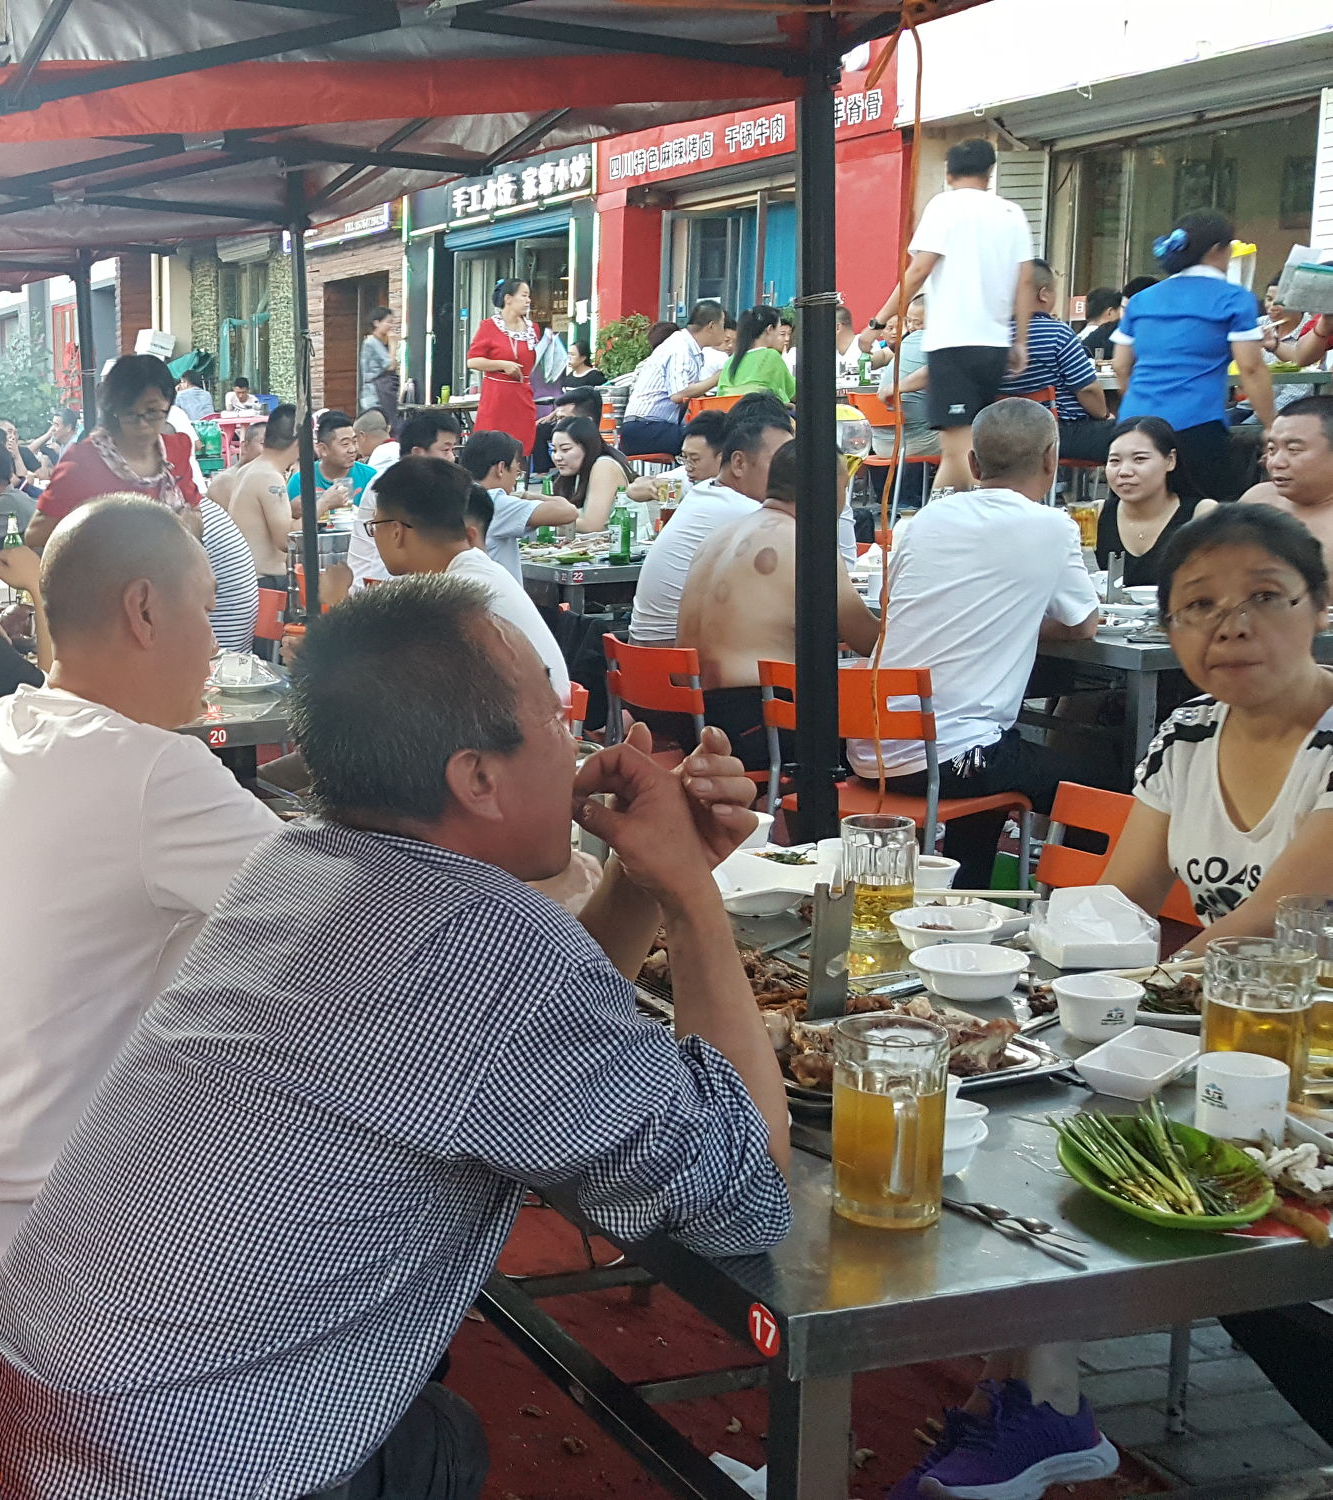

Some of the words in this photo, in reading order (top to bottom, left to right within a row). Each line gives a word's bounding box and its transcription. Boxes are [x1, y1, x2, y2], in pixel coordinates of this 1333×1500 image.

[609, 131, 714, 180] 四川特色麻辣烤卤
[725, 114, 786, 152] 干锅牛肉
[572, 572, 584, 581] 22
[210, 729, 226, 743] 20
[752, 1310, 776, 1349] 17
